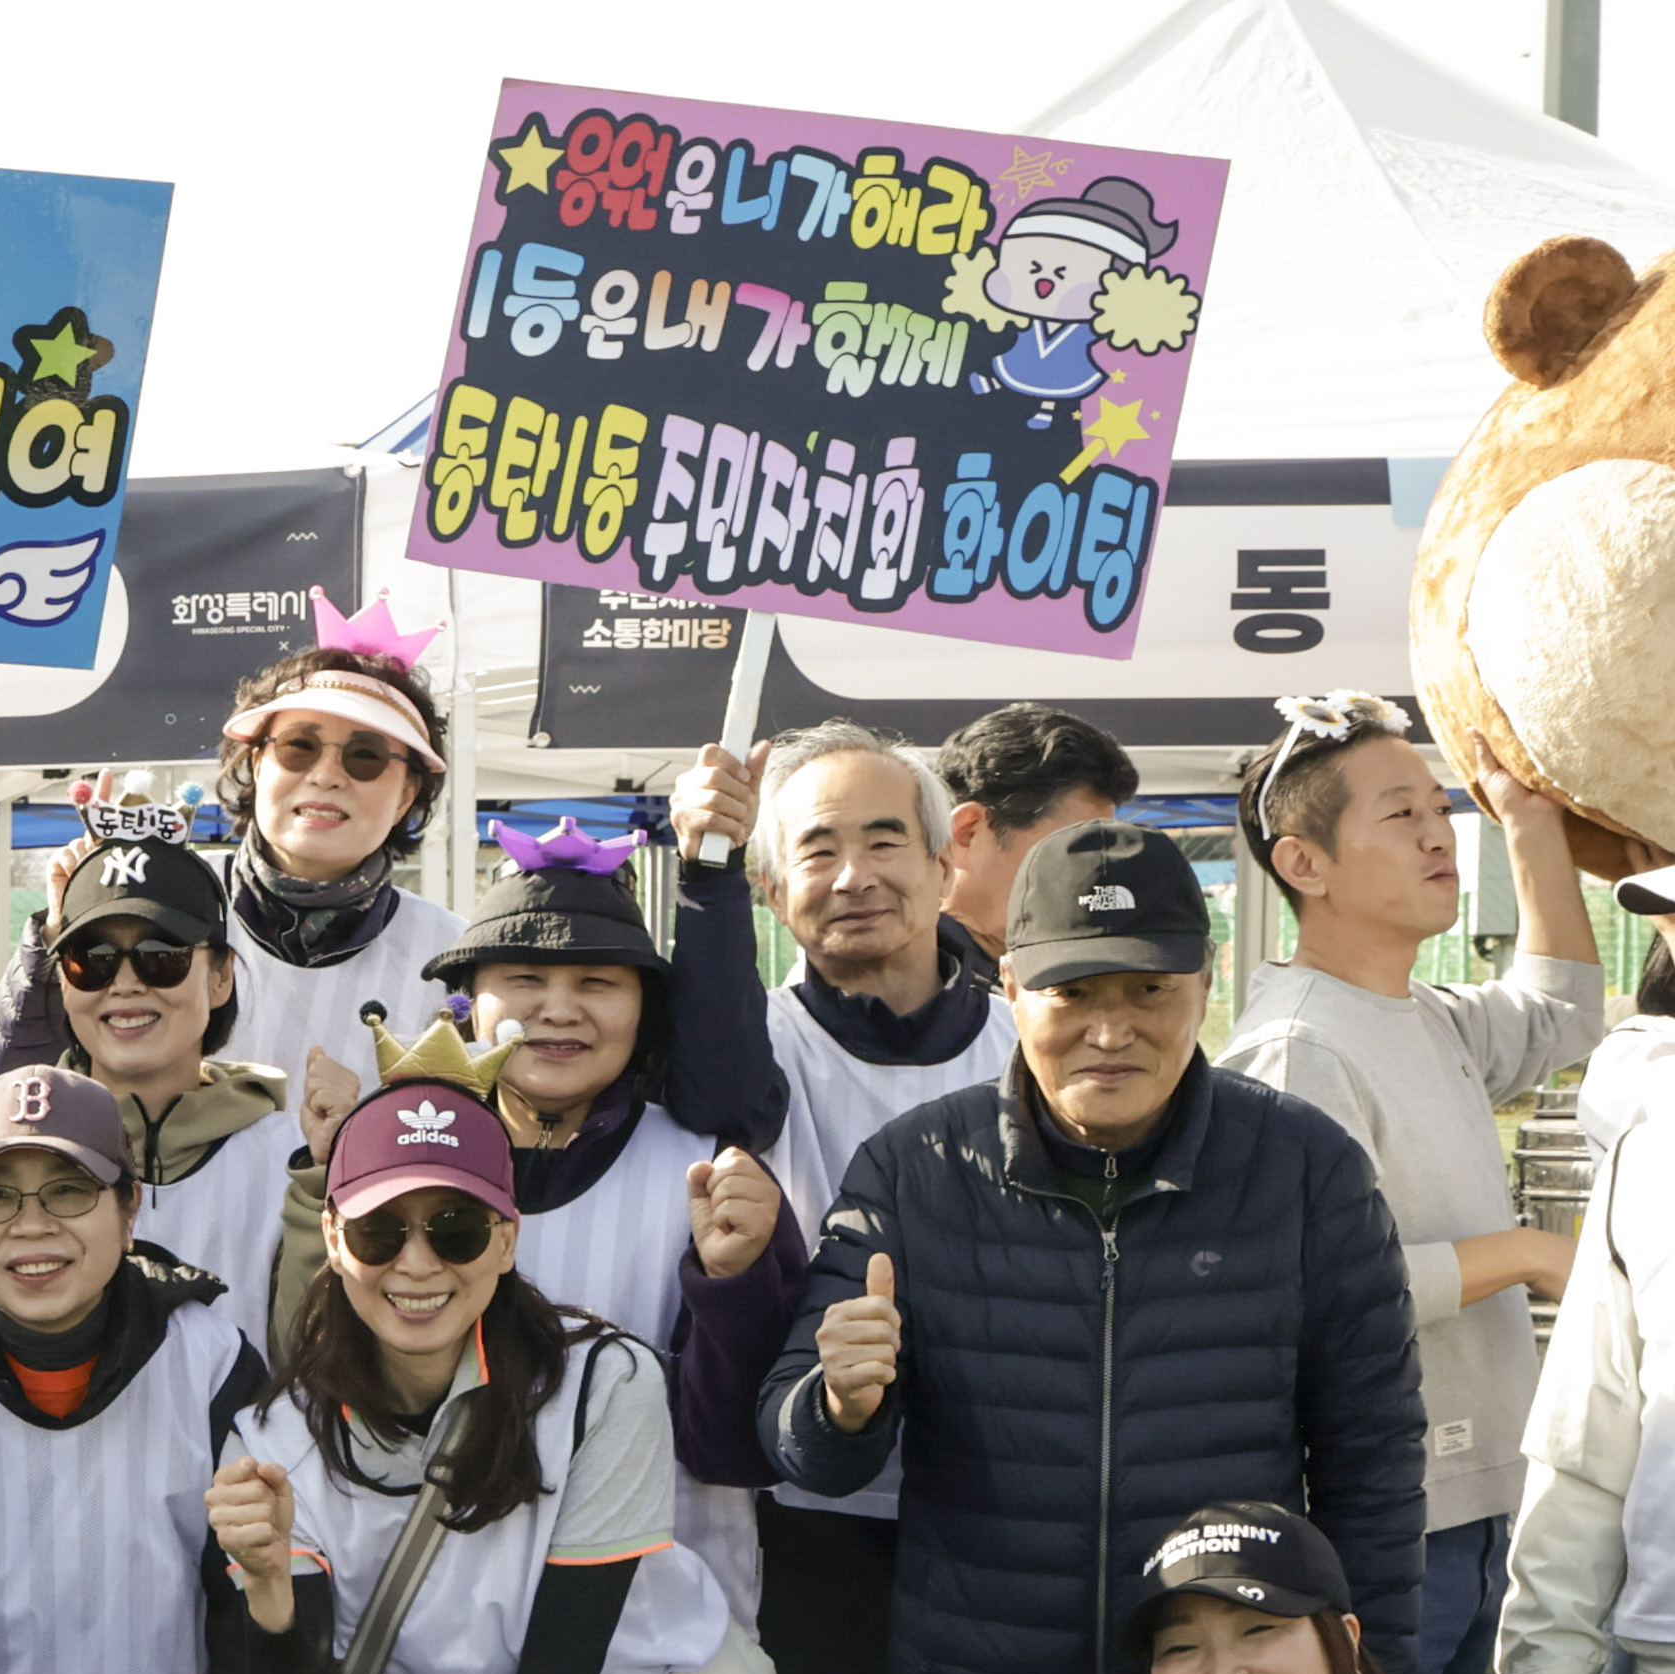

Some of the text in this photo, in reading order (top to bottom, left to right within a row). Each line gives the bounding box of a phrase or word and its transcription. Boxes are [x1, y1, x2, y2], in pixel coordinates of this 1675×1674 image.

[643, 413, 925, 601] 주민자치회
[933, 452, 1150, 626] 화이팅
[172, 590, 307, 625] 화성특례시
[236, 625, 266, 633] SPECIAL
[582, 618, 733, 649] 소통한마당
[1079, 895, 1115, 904] NORTH
[1093, 886, 1115, 895] THE
[1089, 903, 1116, 911] FACE
[10, 1077, 52, 1121] B
[397, 1129, 459, 1147] adidas
[1142, 1523, 1281, 1577] MASTER BUNNY
[1162, 1538, 1241, 1569] EDITION
